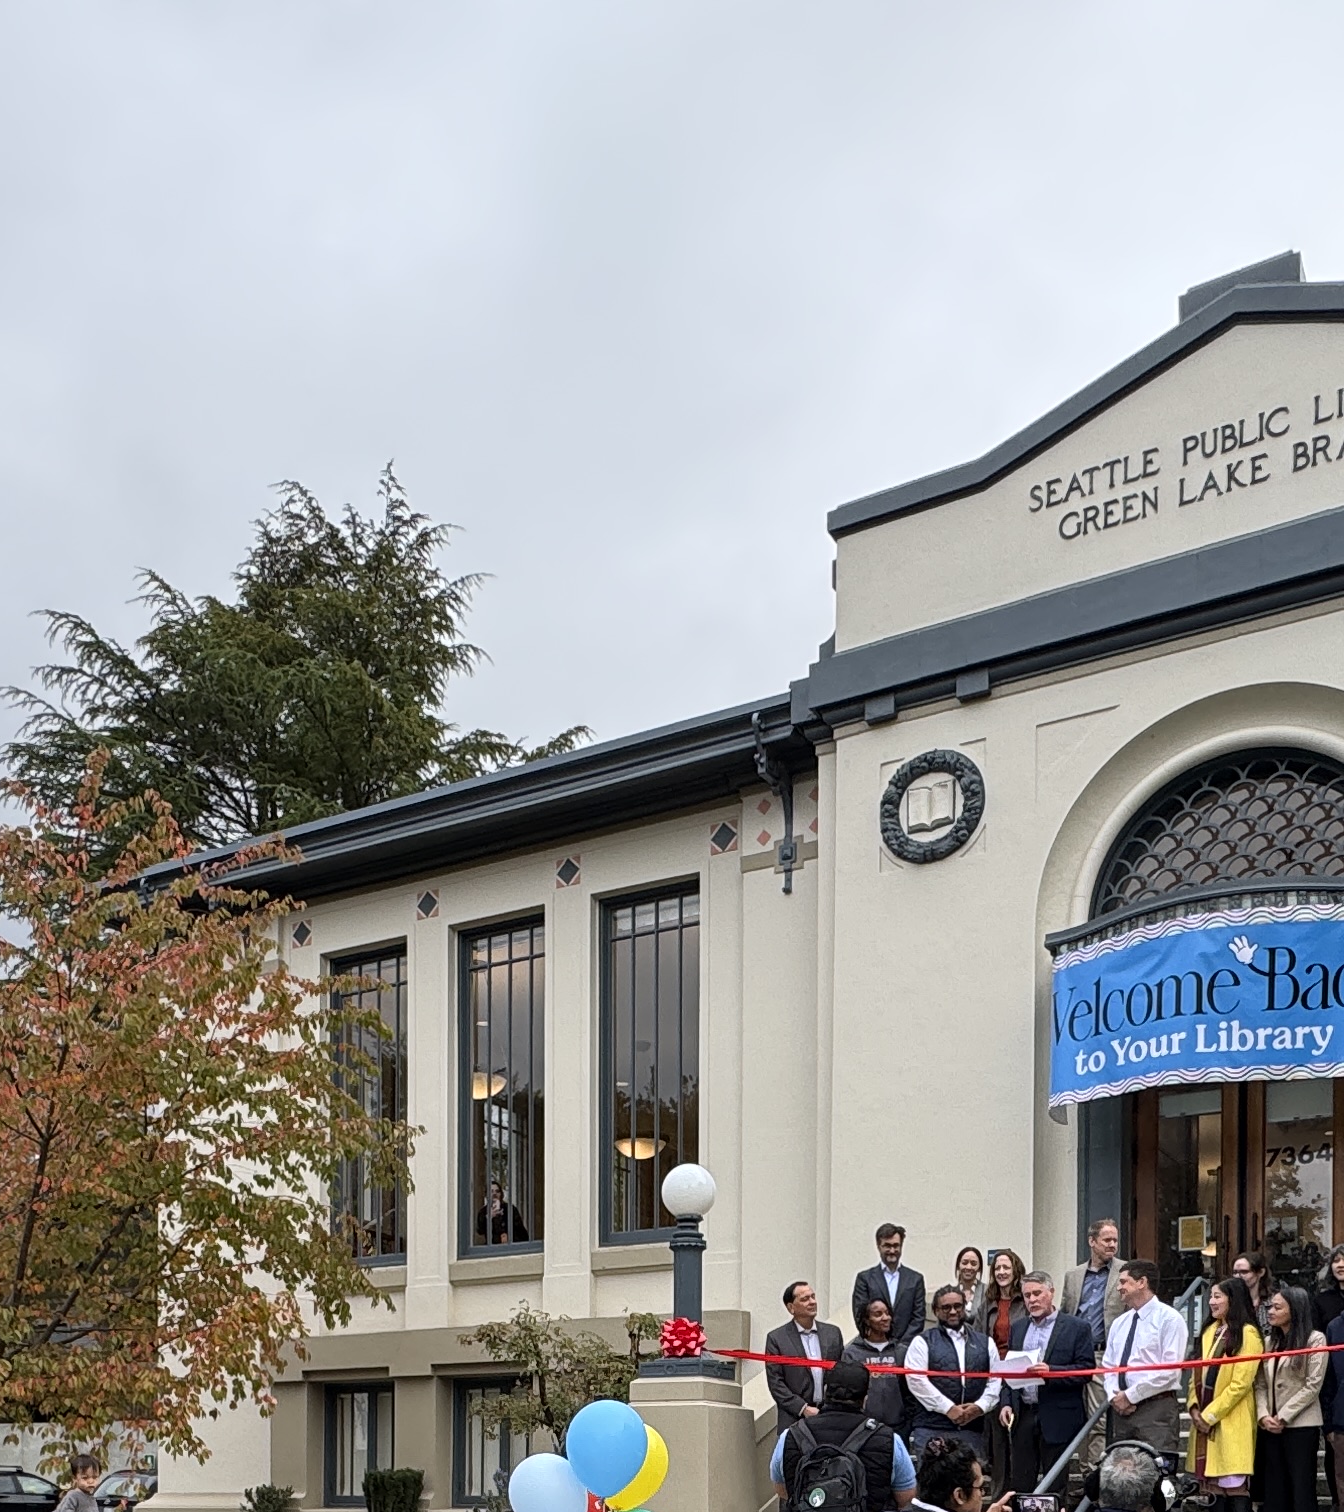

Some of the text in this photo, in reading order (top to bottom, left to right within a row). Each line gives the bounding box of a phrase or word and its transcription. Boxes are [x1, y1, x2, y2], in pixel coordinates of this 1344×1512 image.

[1029, 447, 1161, 513] SEATTLE
[1182, 407, 1291, 466] PUBLIC
[1058, 487, 1159, 541] GREEN
[1178, 453, 1271, 508] LAKE
[1074, 1020, 1334, 1075] to Your Library
[1266, 1142, 1333, 1167] 7364
